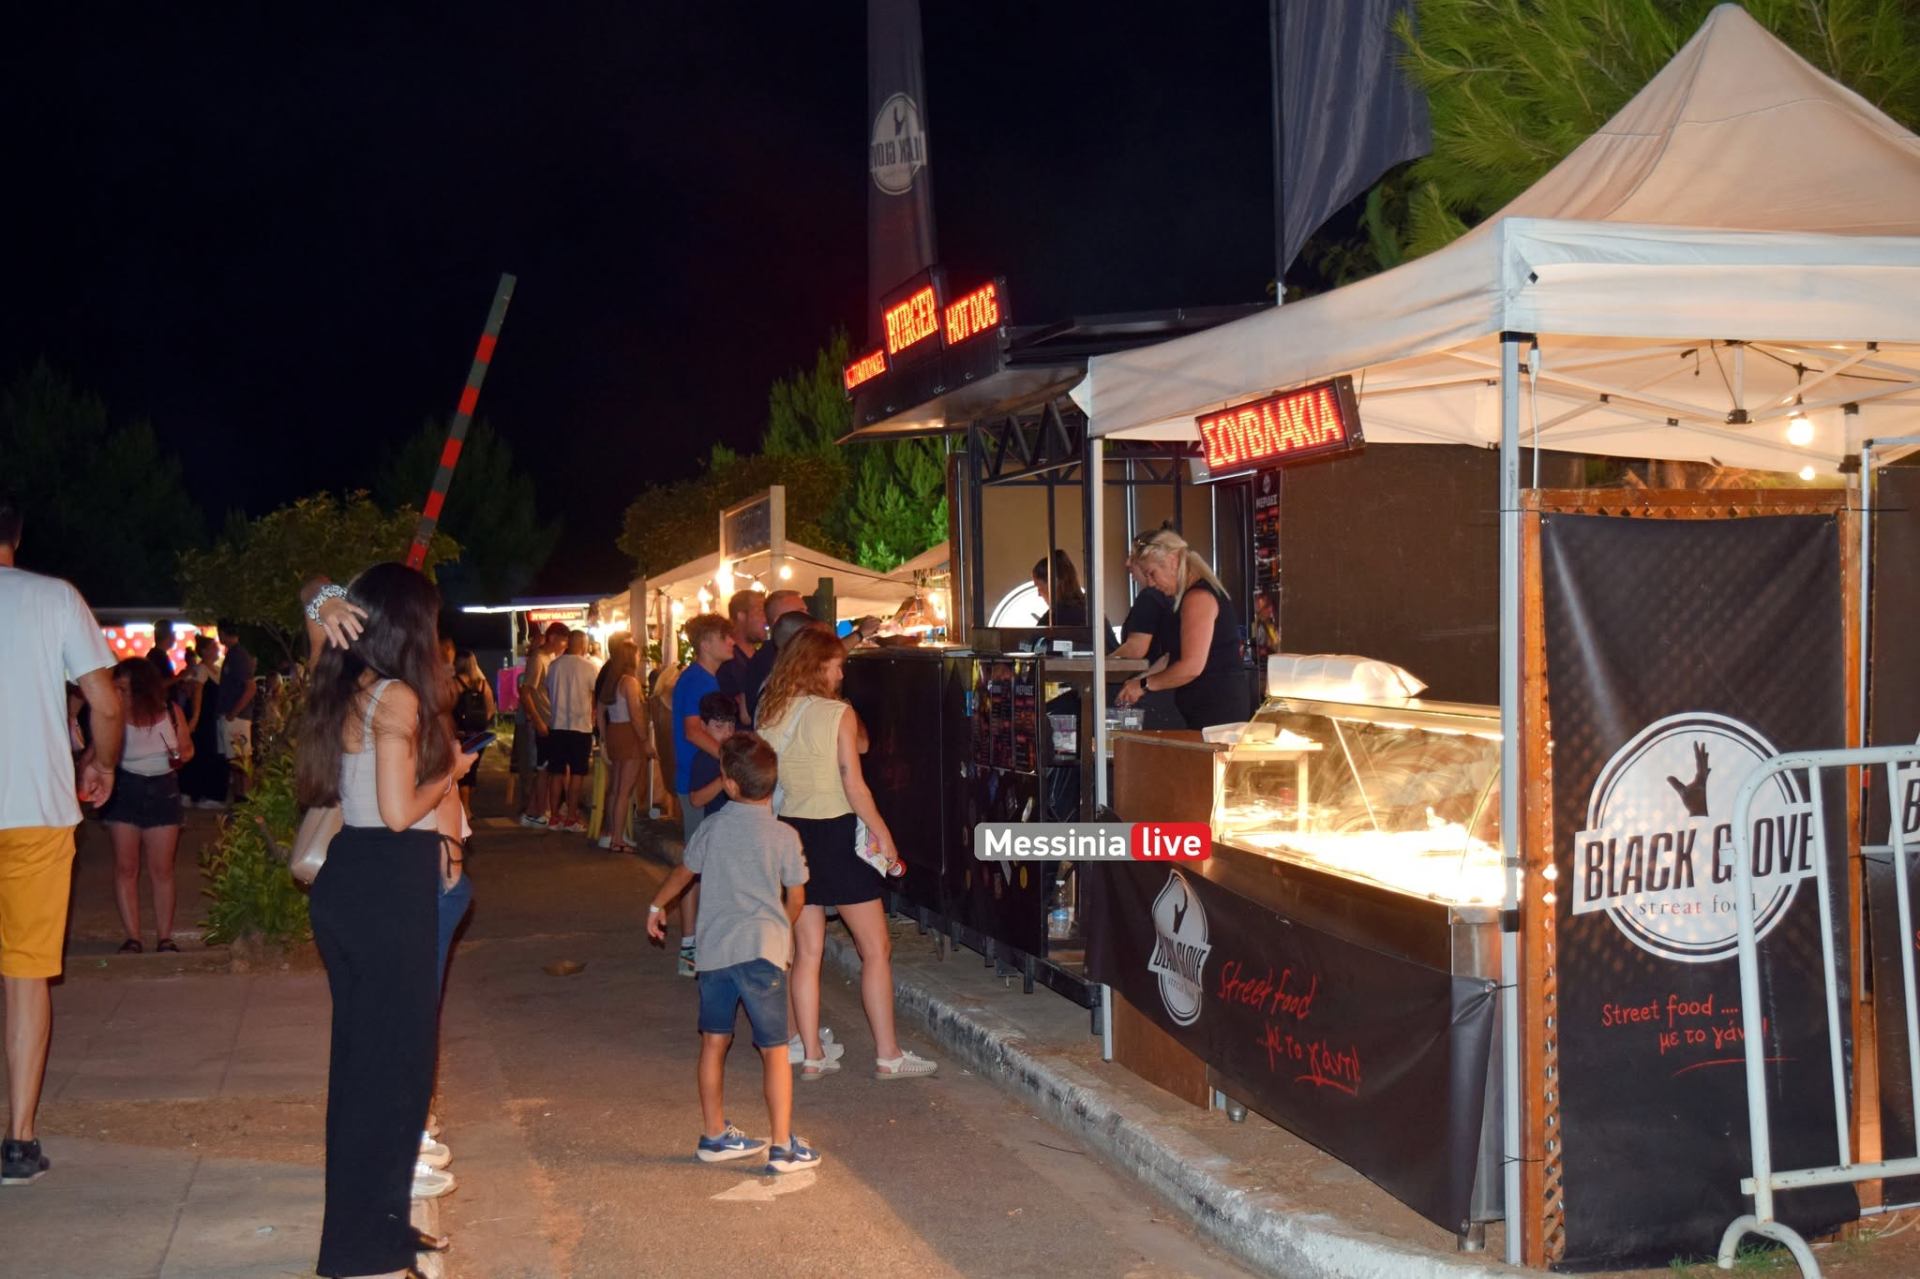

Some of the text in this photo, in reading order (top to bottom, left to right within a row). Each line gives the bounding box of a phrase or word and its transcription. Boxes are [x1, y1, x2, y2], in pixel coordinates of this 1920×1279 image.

[886, 286, 938, 354] BURGER
[946, 284, 997, 344] HOT DOG
[1202, 390, 1341, 467] ΣΟΥΒΛΑΚΙΑ
[1584, 811, 1814, 902] BLACK GOVE
[1639, 901, 1703, 915] streat
[1217, 960, 1273, 1010] Street
[1273, 968, 1317, 1020] food
[1601, 1001, 1661, 1028] Street
[1666, 994, 1714, 1028] food
[1659, 1031, 1680, 1056] με
[1684, 1029, 1706, 1043] το
